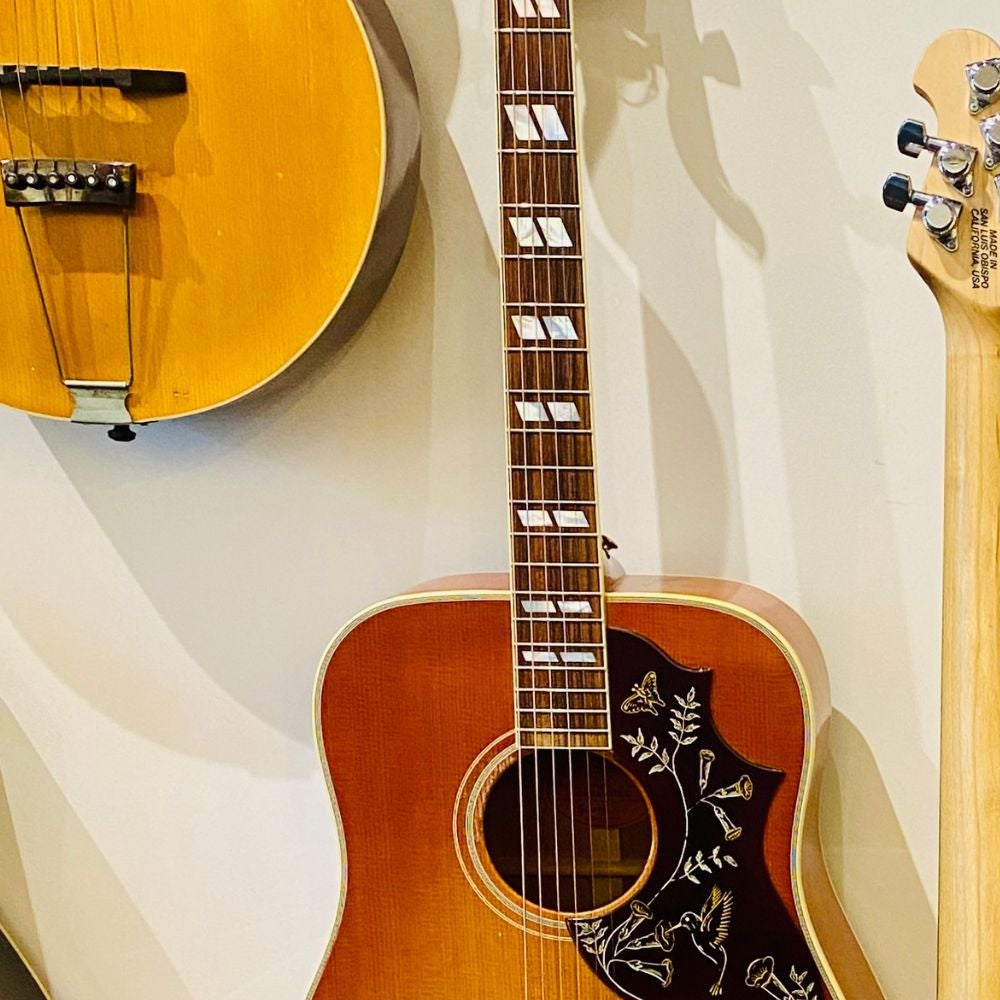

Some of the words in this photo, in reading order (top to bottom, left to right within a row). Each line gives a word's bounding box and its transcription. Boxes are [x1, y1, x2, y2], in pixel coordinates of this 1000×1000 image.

[980, 208, 989, 228] SAN
[971, 208, 980, 267] CALIFORNIA,
[980, 229, 989, 251] LUIS
[989, 229, 998, 258] MADE
[980, 252, 989, 289] OBISPO
[989, 259, 998, 270] IN
[971, 269, 980, 289] USA
